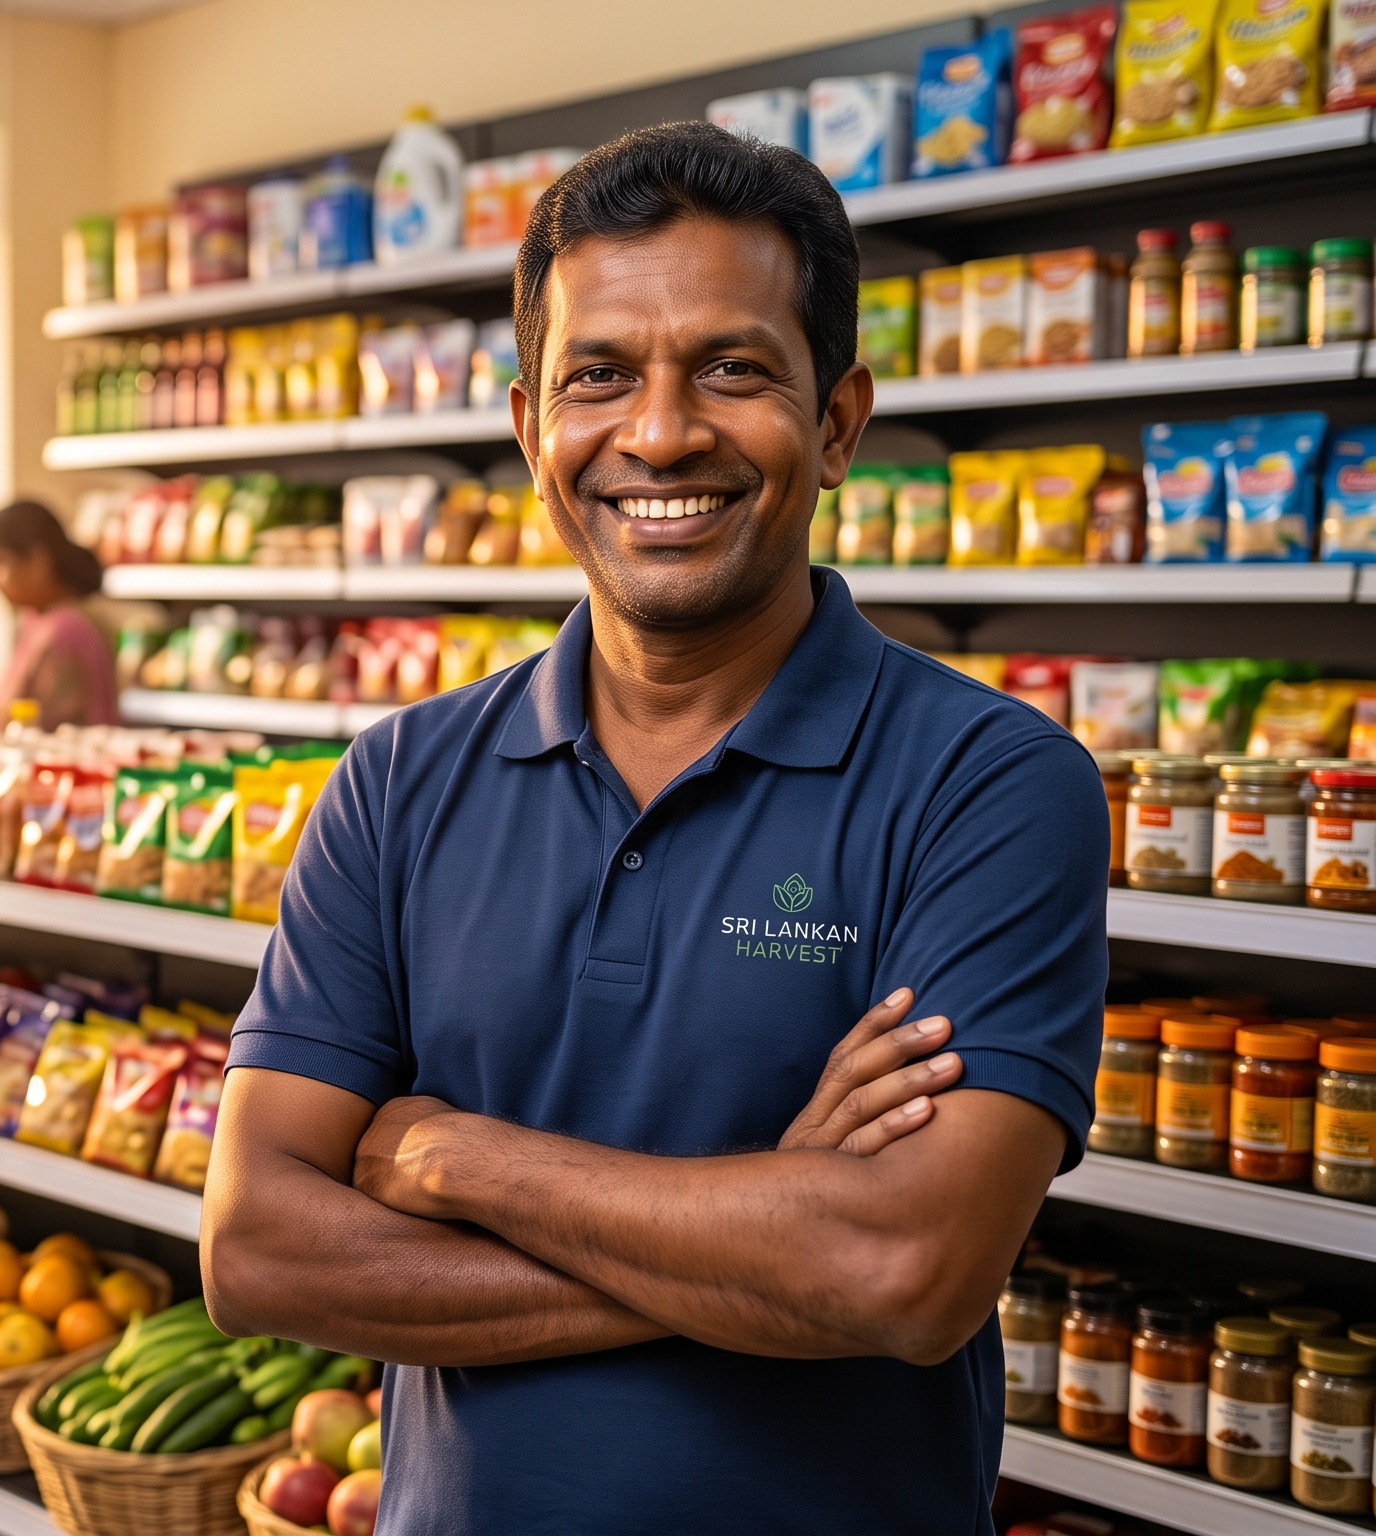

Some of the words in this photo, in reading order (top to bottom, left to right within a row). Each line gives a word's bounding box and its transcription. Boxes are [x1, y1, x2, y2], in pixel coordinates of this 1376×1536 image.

[721, 916, 757, 935] SRI
[764, 919, 858, 943] LANKAN
[736, 939, 843, 964] HARVEST
